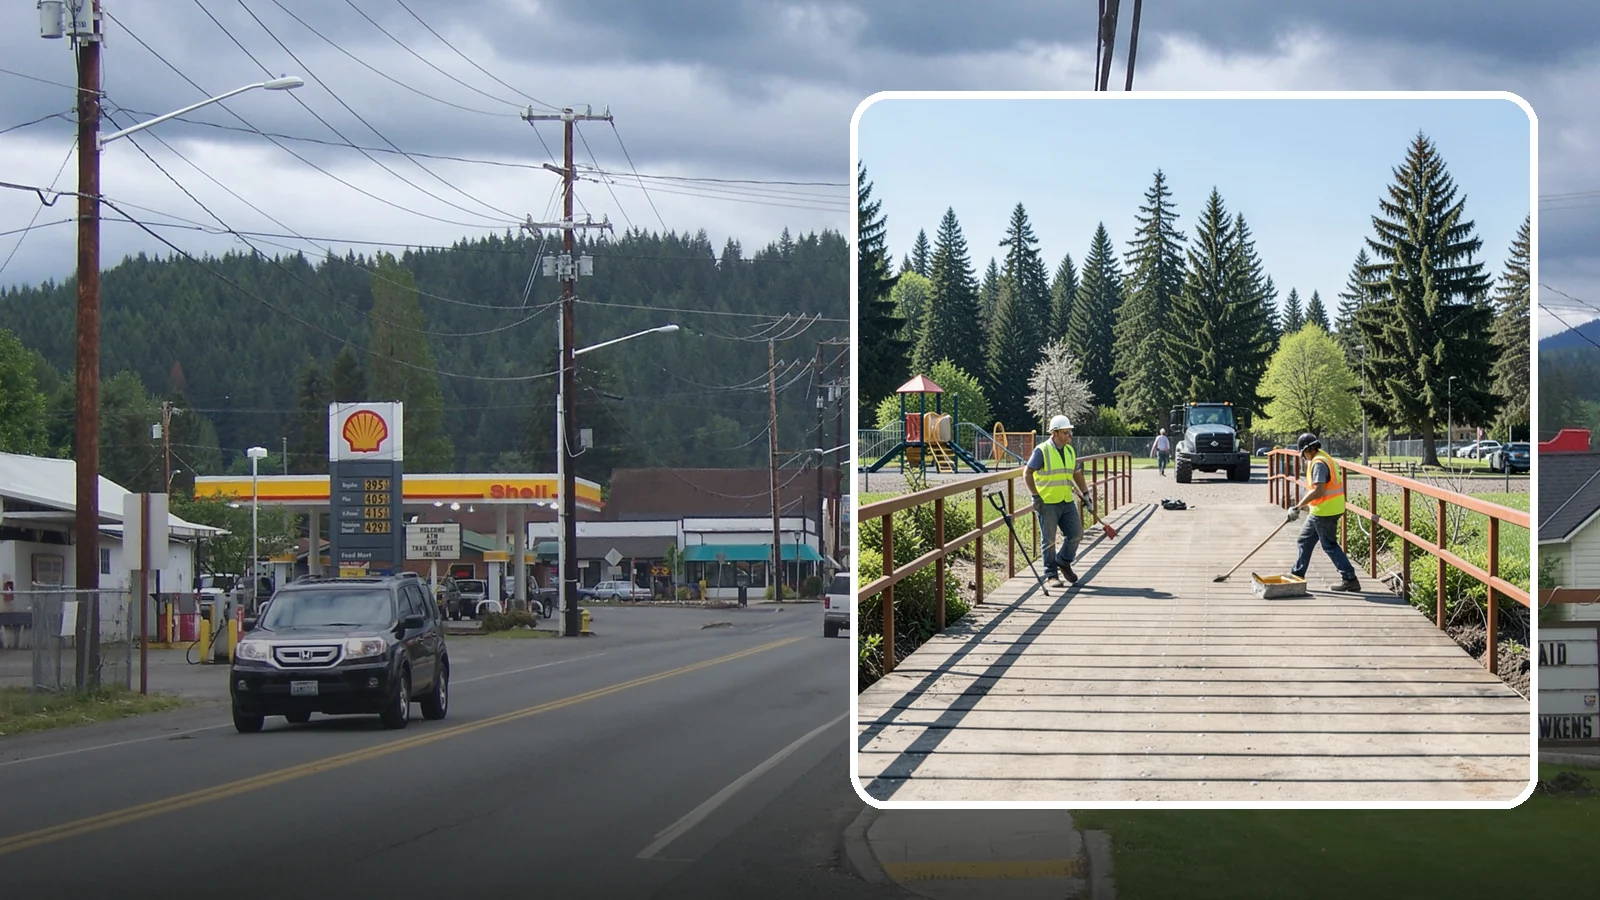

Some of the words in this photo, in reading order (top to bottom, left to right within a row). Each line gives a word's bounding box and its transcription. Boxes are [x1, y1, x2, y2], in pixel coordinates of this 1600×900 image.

[366, 480, 383, 490] 395
[490, 484, 547, 499] Shell
[366, 494, 383, 504] 405
[366, 508, 383, 518] 415
[366, 522, 383, 532] 429
